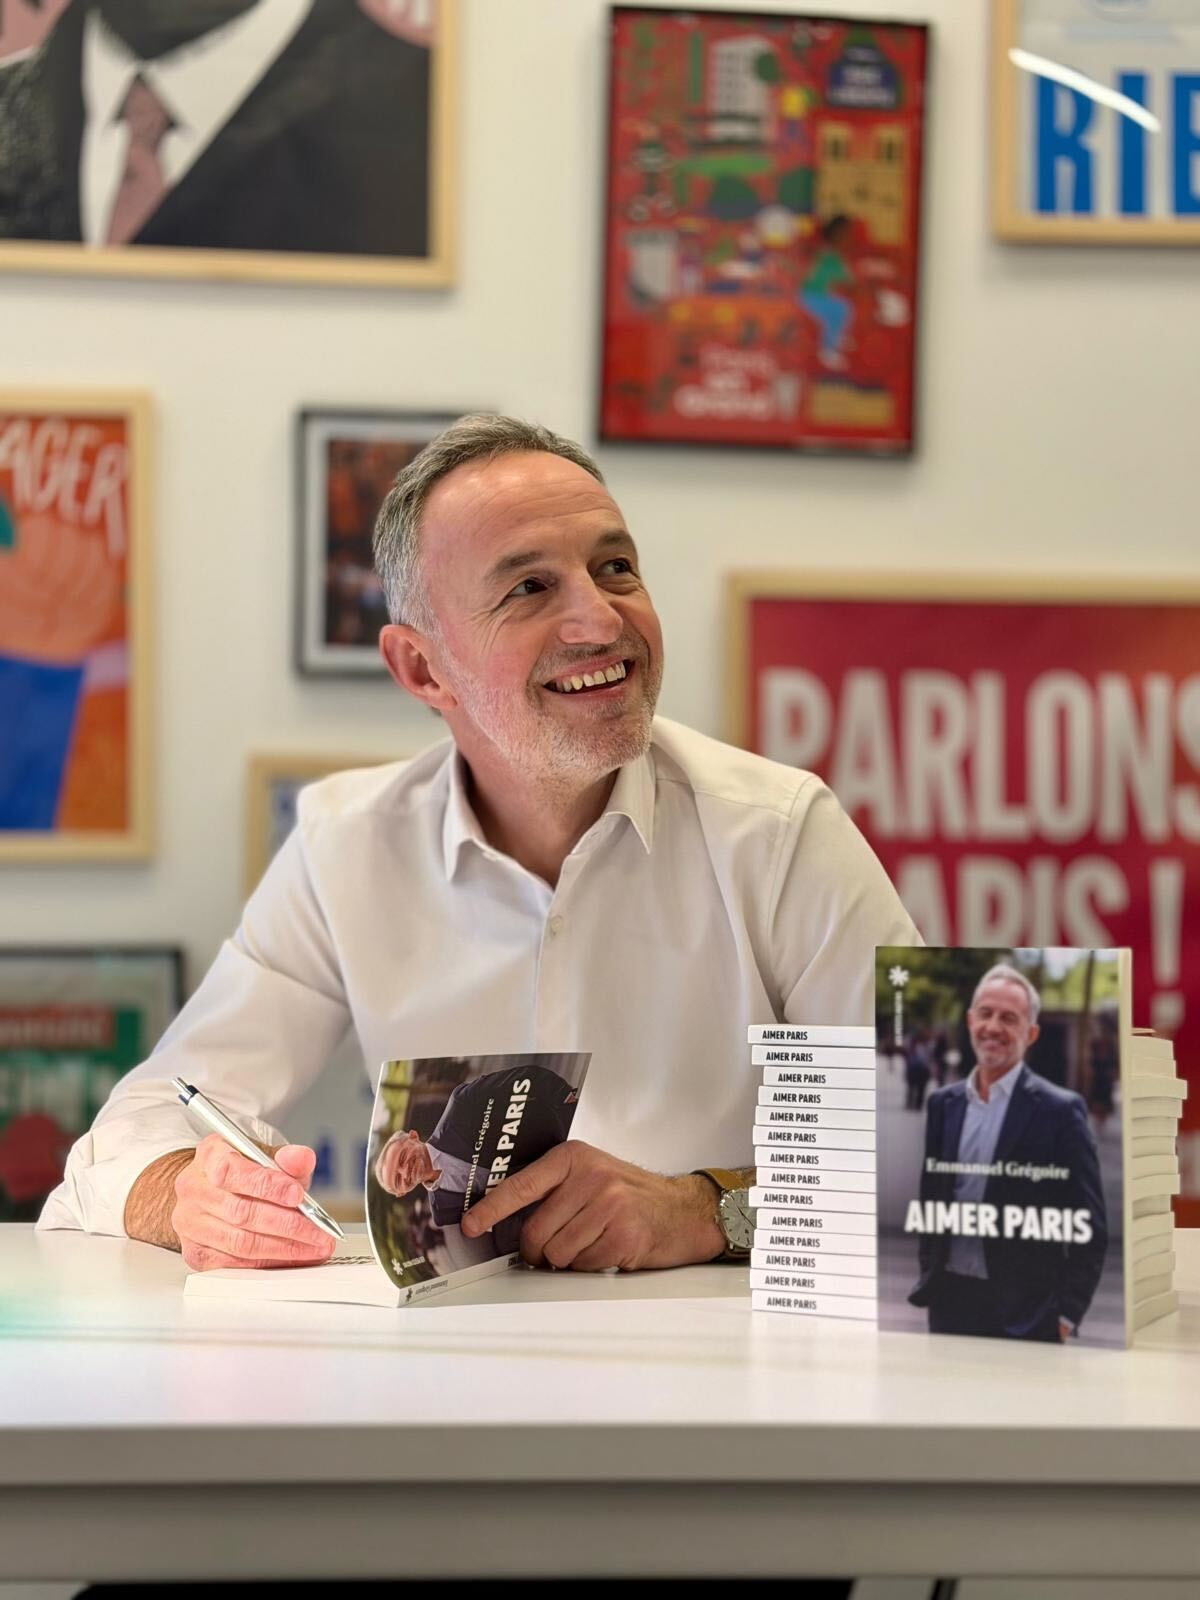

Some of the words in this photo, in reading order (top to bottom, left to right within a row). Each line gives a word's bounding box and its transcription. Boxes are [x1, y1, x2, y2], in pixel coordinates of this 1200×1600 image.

[762, 1030, 785, 1040] AIMER
[787, 1031, 808, 1040] PARIS
[766, 1052, 789, 1061] AIMER
[791, 1053, 813, 1062] PARIS
[778, 1073, 802, 1082] AIMER
[804, 1074, 826, 1083] PARIS
[773, 1093, 796, 1102] AIMER
[799, 1094, 821, 1103] PARIS
[497, 1078, 532, 1151] PARIS
[770, 1112, 793, 1121] AIMER
[796, 1113, 818, 1123] PARIS
[768, 1132, 792, 1141] AIMER
[794, 1133, 816, 1142] PARIS
[464, 1154, 480, 1211] mmanuel
[474, 1098, 495, 1151] Grégoire
[770, 1154, 794, 1163] AIMER
[797, 1155, 819, 1164] PARIS
[926, 1157, 1003, 1176] Emmanuel
[1005, 1161, 1070, 1182] Grégoire
[771, 1173, 796, 1183] AIMER
[798, 1175, 820, 1184] PARIS
[764, 1193, 788, 1203] AIMER
[790, 1195, 813, 1205] PARIS
[772, 1216, 797, 1226] AIMER
[800, 1218, 823, 1228] PARIS
[904, 1199, 999, 1238] AIMER
[1003, 1204, 1093, 1244] PARIS
[770, 1235, 794, 1246] AIMER
[797, 1237, 820, 1247] PARIS
[766, 1255, 790, 1265] AIMER
[792, 1257, 815, 1268] PARIS
[765, 1276, 789, 1286] AIMER
[792, 1278, 815, 1288] PARIS
[767, 1297, 791, 1307] AIMER
[794, 1299, 817, 1310] PARIS
